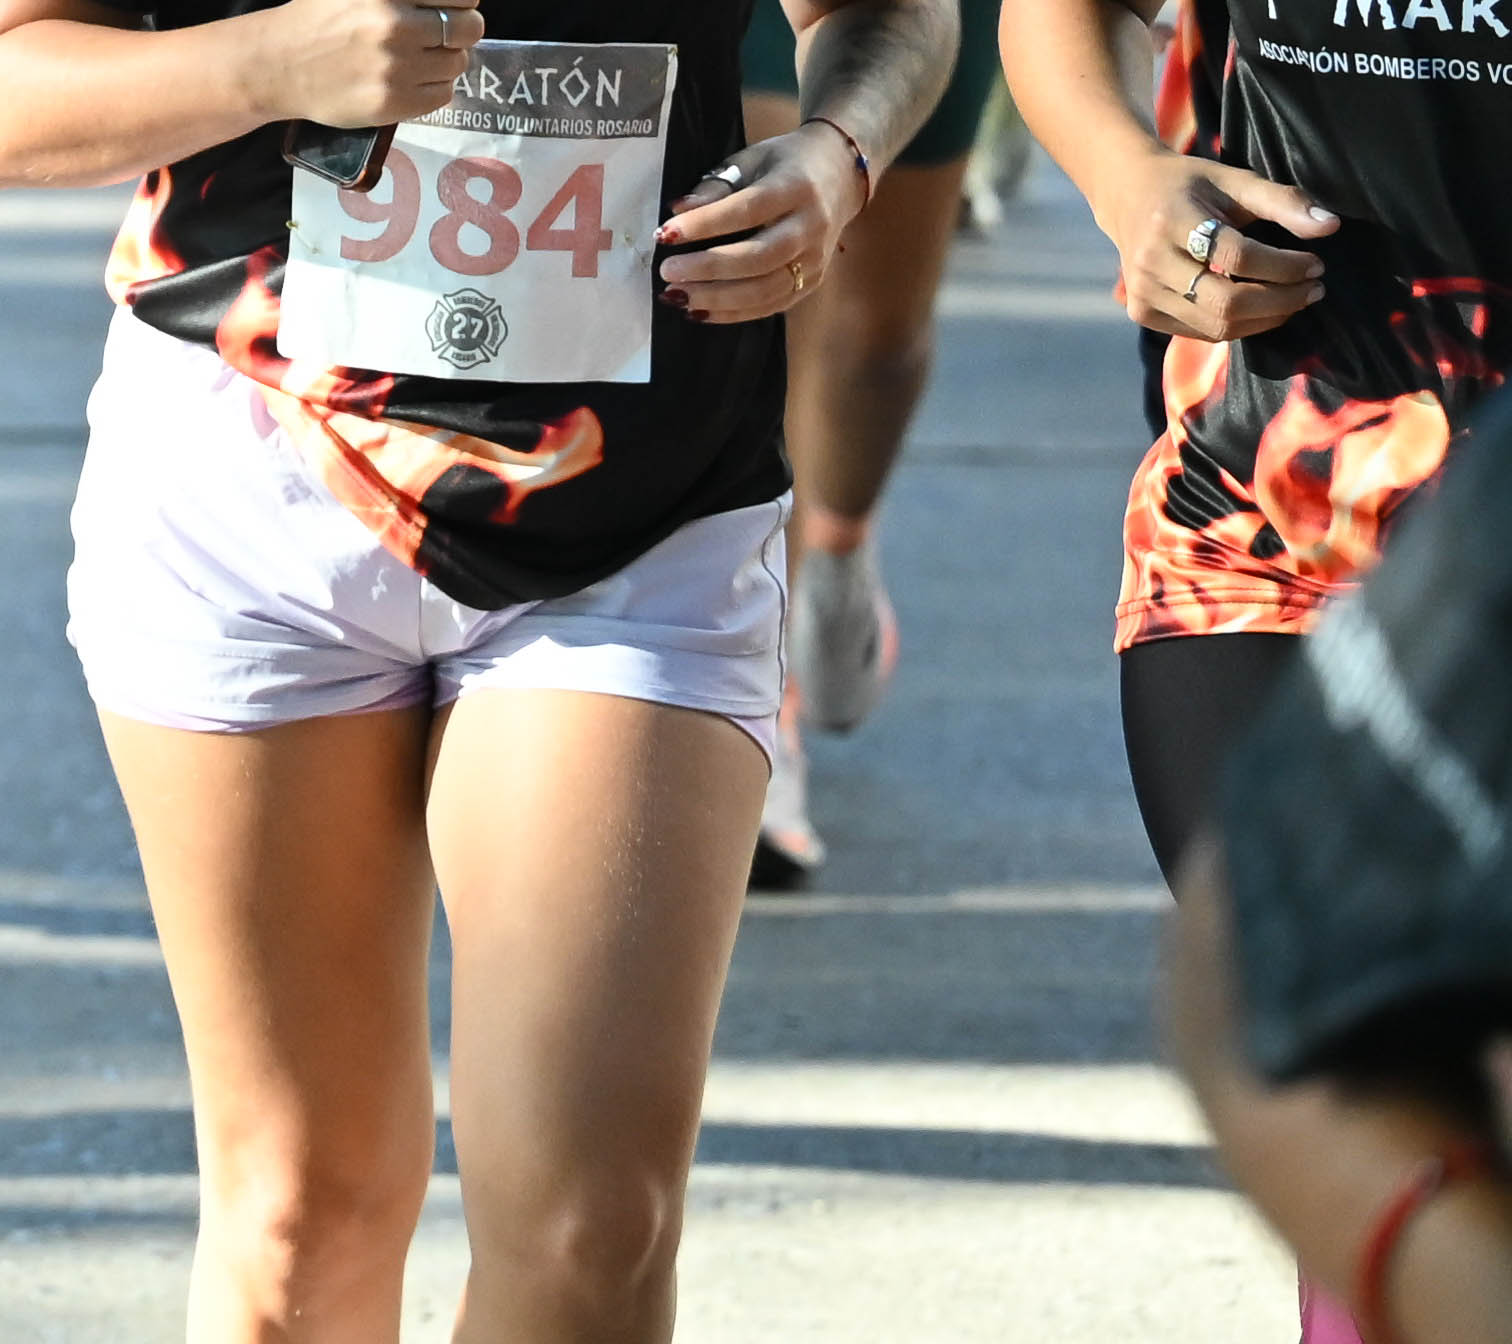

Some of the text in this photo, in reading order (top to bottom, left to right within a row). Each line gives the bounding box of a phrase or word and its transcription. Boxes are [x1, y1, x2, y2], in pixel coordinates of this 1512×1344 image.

[451, 55, 623, 108] ARATÓN
[1353, 52, 1481, 83] BOMBEROS
[496, 114, 593, 136] VOLUNTARIOS
[596, 117, 652, 137] ROSARIO
[336, 145, 614, 279] 984
[451, 312, 484, 340] 27
